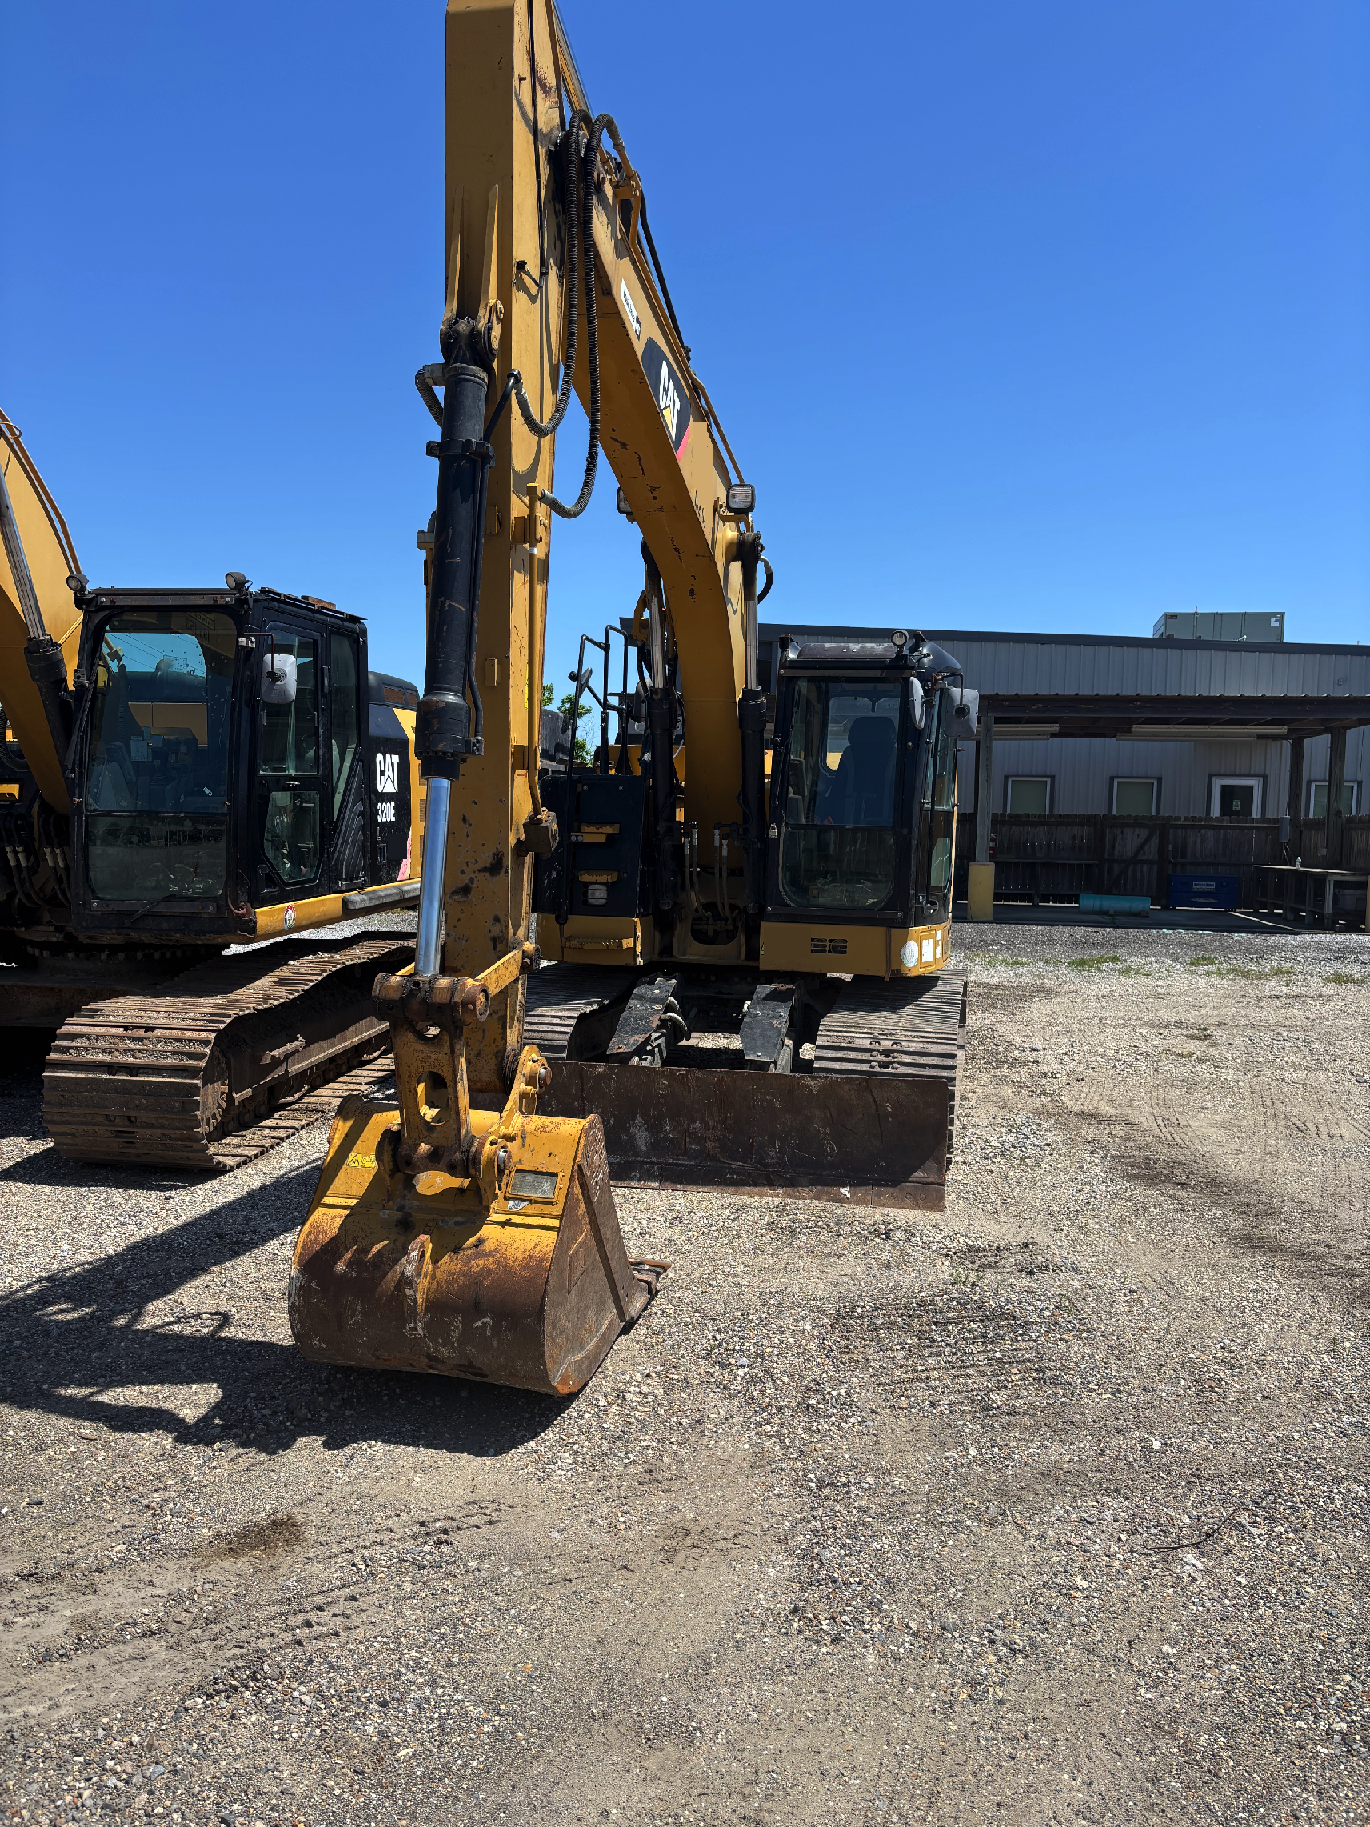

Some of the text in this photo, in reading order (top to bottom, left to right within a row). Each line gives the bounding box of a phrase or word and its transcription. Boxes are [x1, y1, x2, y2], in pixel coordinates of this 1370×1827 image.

[659, 360, 681, 442] CAT
[376, 753, 400, 793] CAT
[376, 801, 396, 823] 320E
